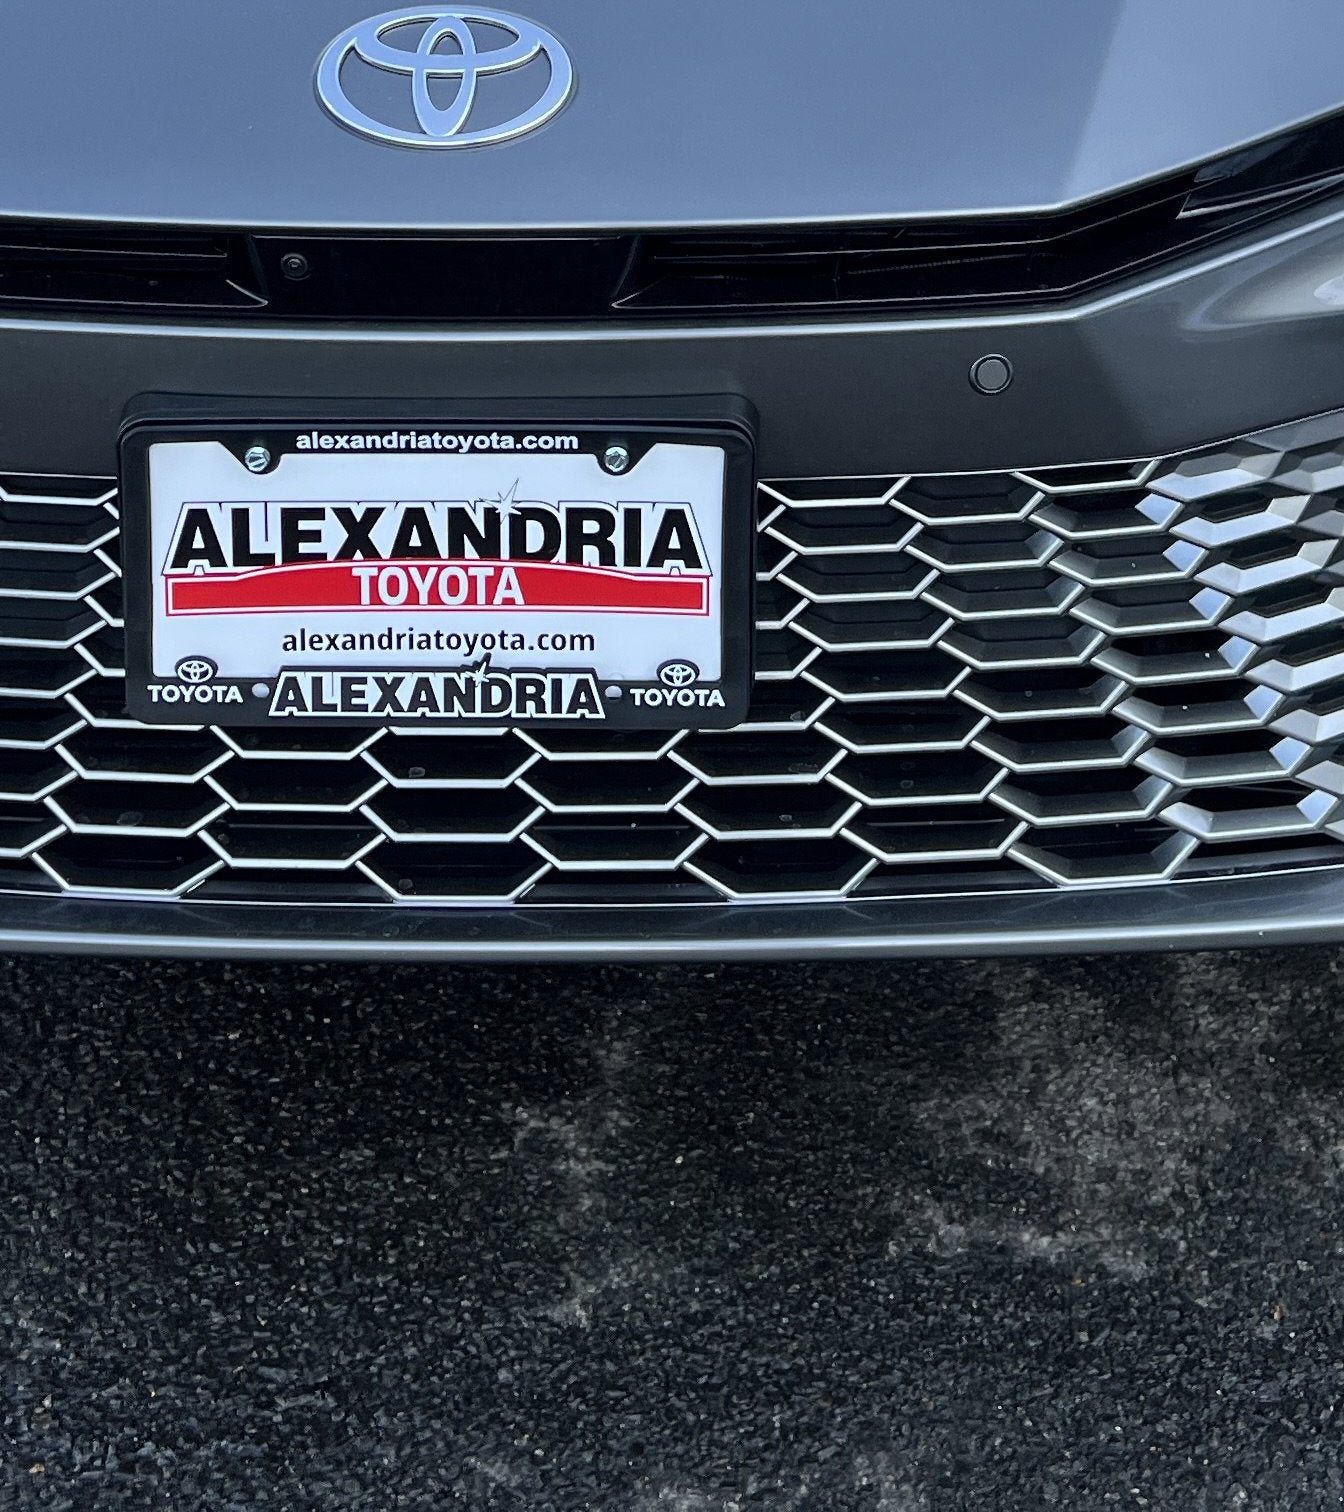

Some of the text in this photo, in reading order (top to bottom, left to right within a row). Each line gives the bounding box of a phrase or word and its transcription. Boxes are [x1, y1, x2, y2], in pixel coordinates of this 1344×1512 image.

[295, 431, 579, 454] alexandriatoyota.com
[168, 506, 703, 569] ALEXANDRIA
[351, 566, 525, 606] TOYOTA
[282, 627, 595, 657] alexandriatoyota.com
[147, 672, 726, 719] TOYOTA ALEXANDRIA TOYOTA
